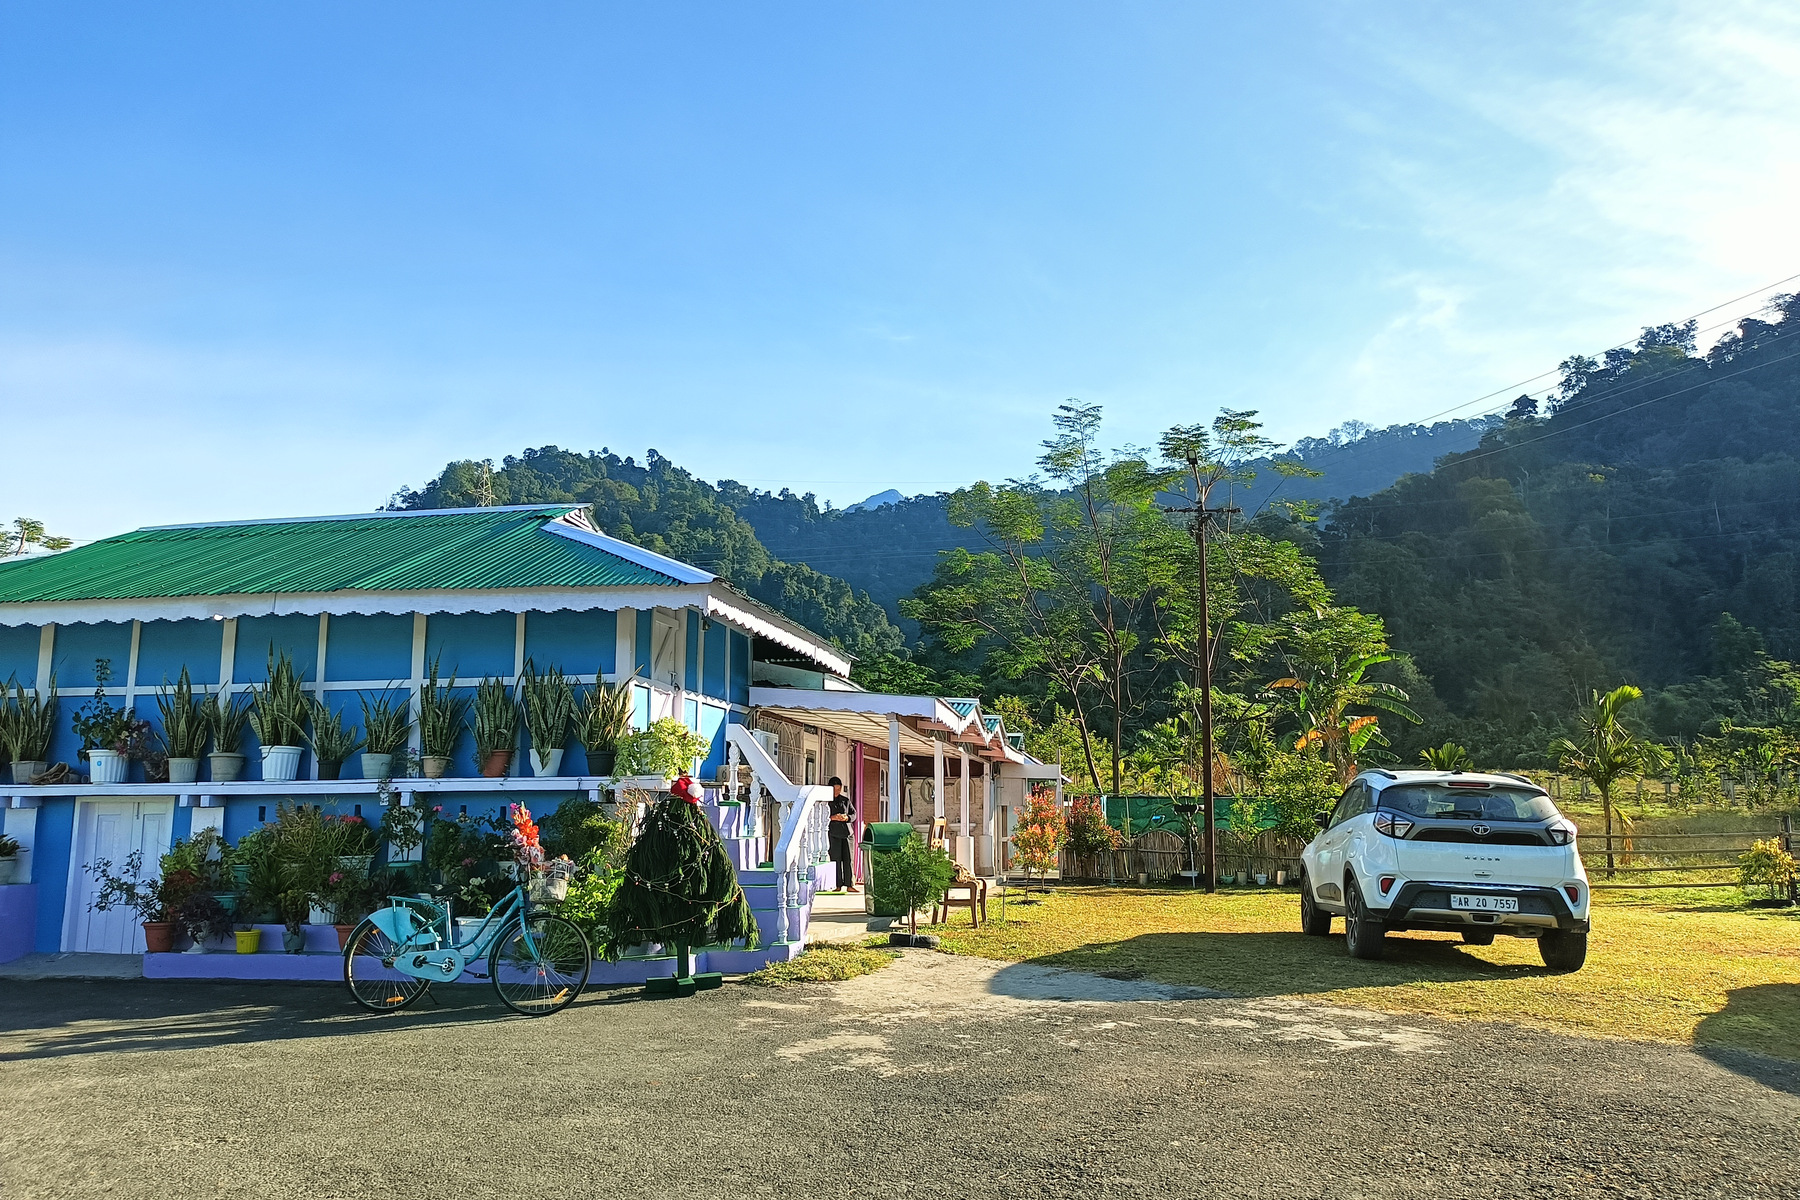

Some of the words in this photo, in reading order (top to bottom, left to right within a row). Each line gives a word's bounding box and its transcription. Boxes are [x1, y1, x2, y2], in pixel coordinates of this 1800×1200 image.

[1458, 897, 1469, 907] AR
[1476, 898, 1487, 908] 20
[1493, 899, 1517, 909] 7557
